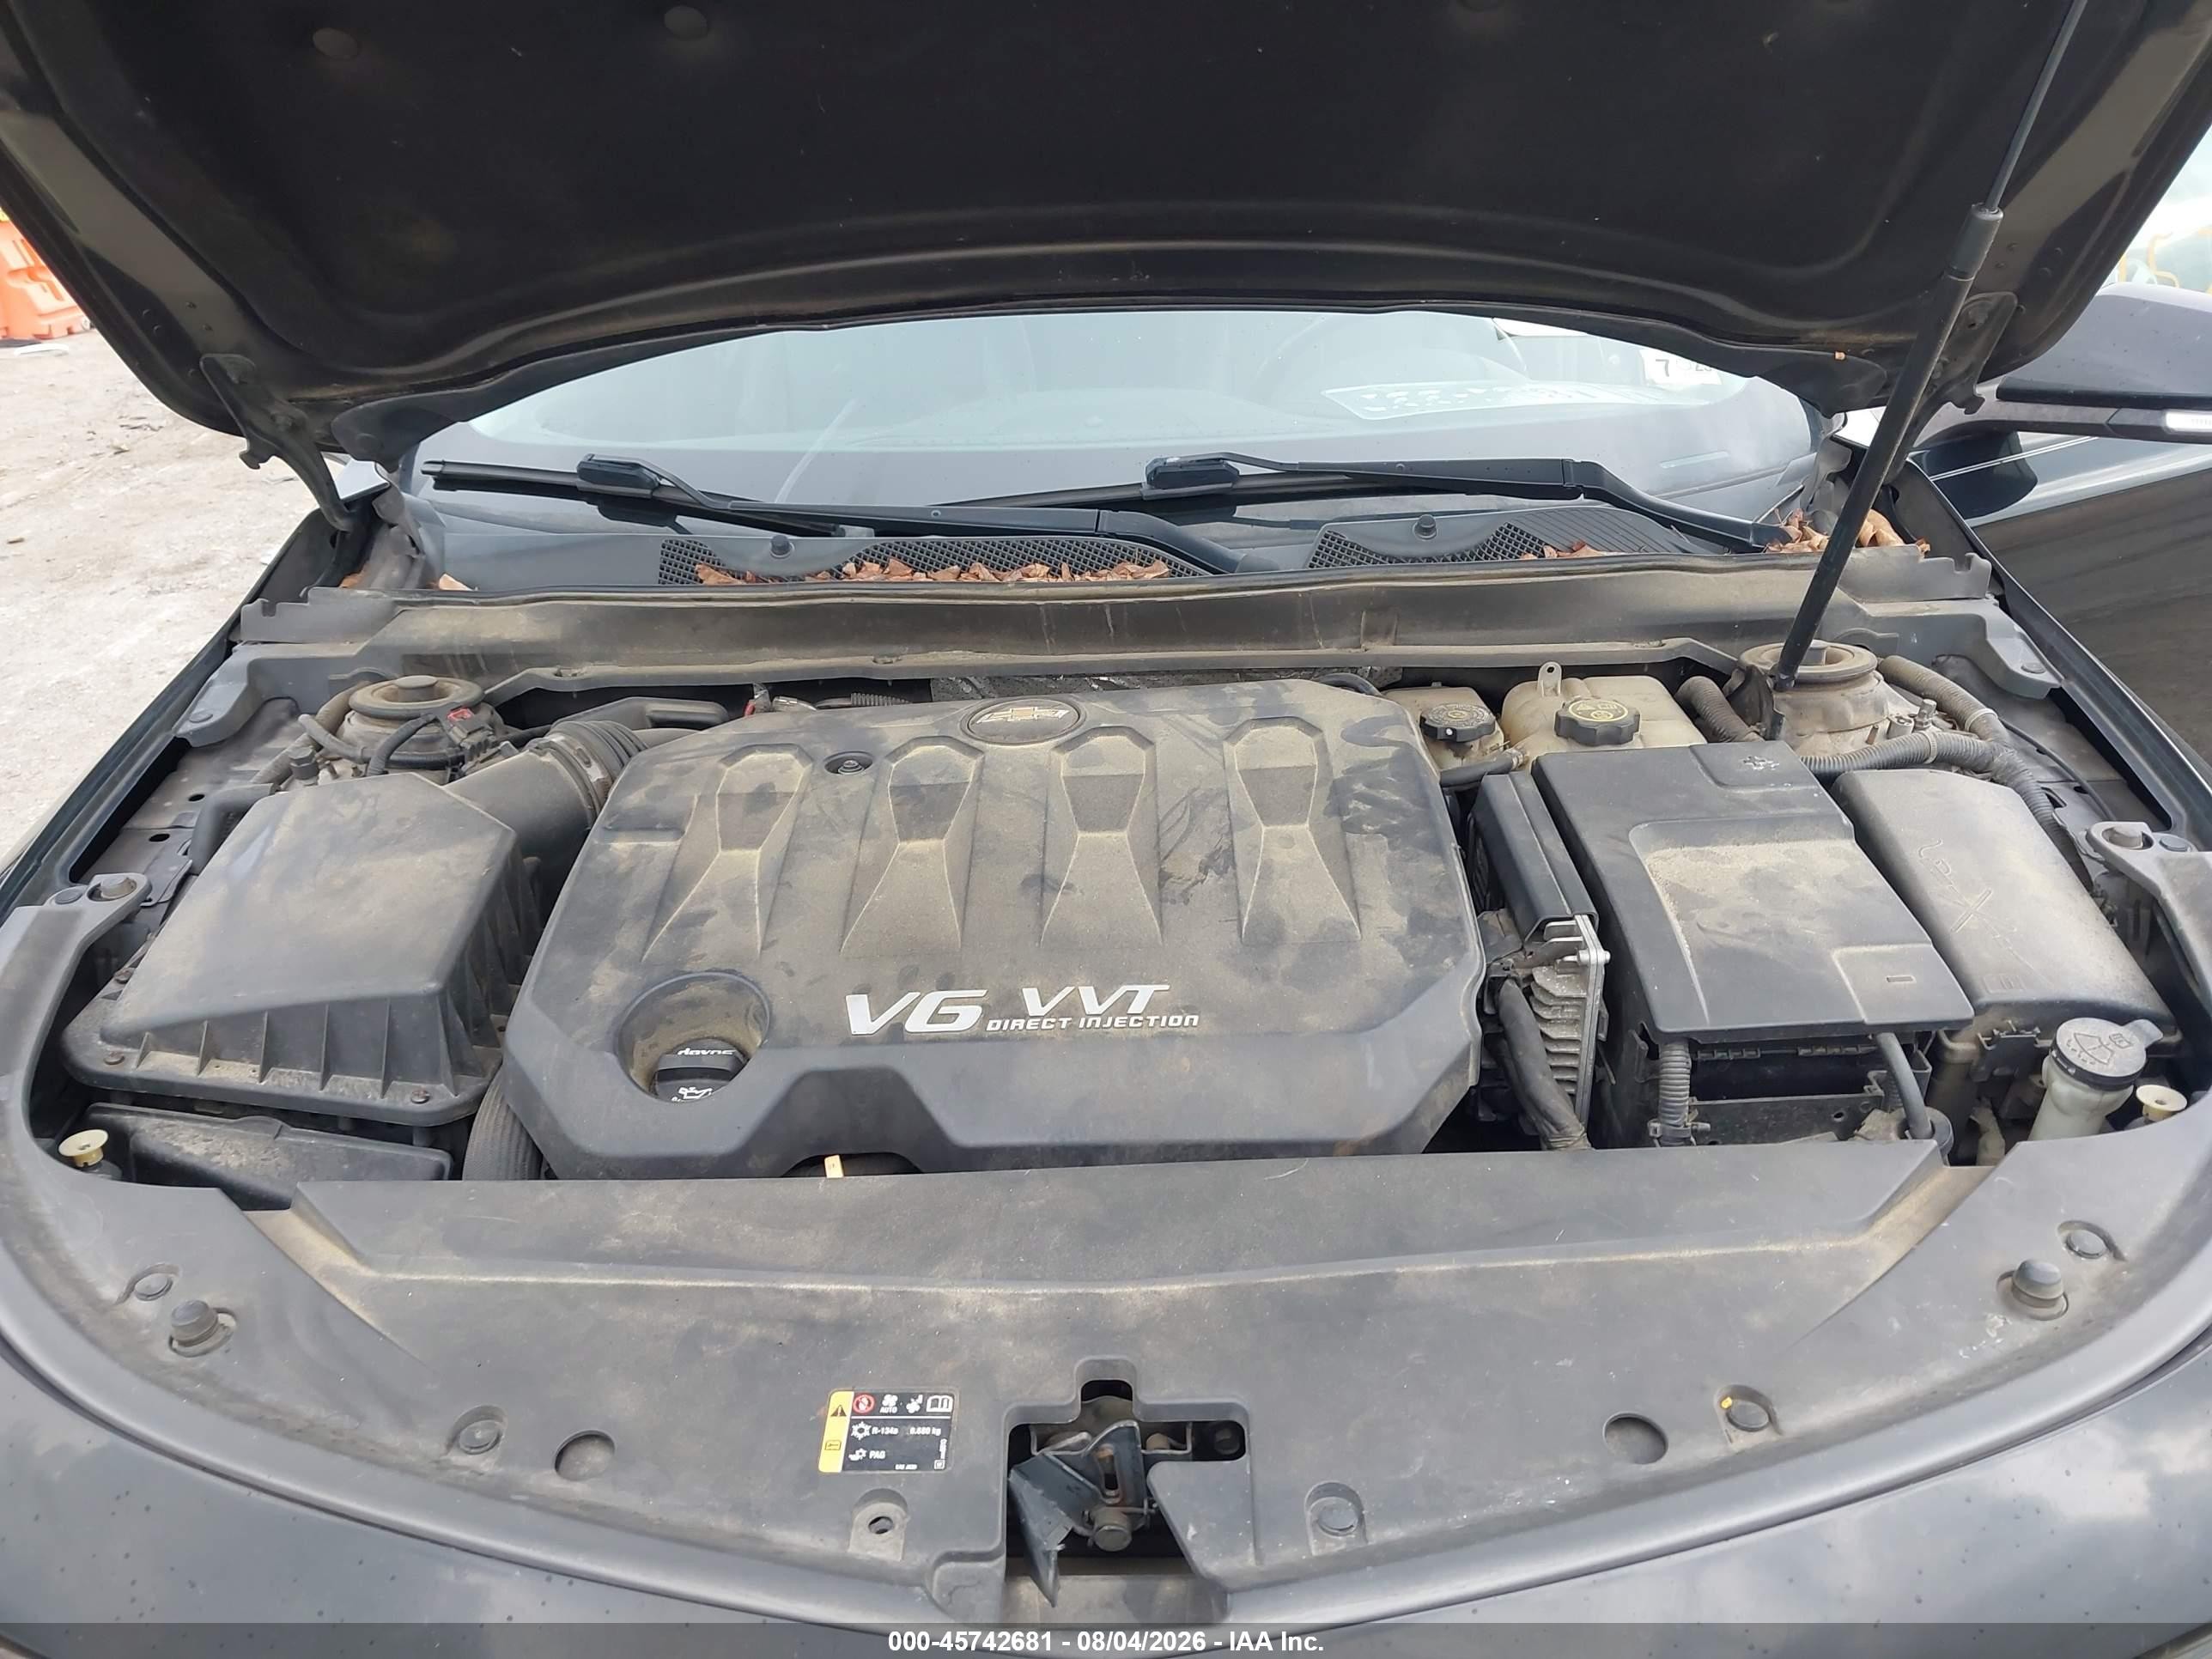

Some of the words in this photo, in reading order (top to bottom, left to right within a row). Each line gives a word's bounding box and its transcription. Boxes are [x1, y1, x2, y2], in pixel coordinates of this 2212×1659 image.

[845, 989, 988, 1036] V6
[1022, 984, 1170, 1017] VVT
[986, 1017, 1072, 1031] DIRECT
[1079, 1014, 1200, 1030] INJECTION
[869, 1450, 885, 1459] PAG
